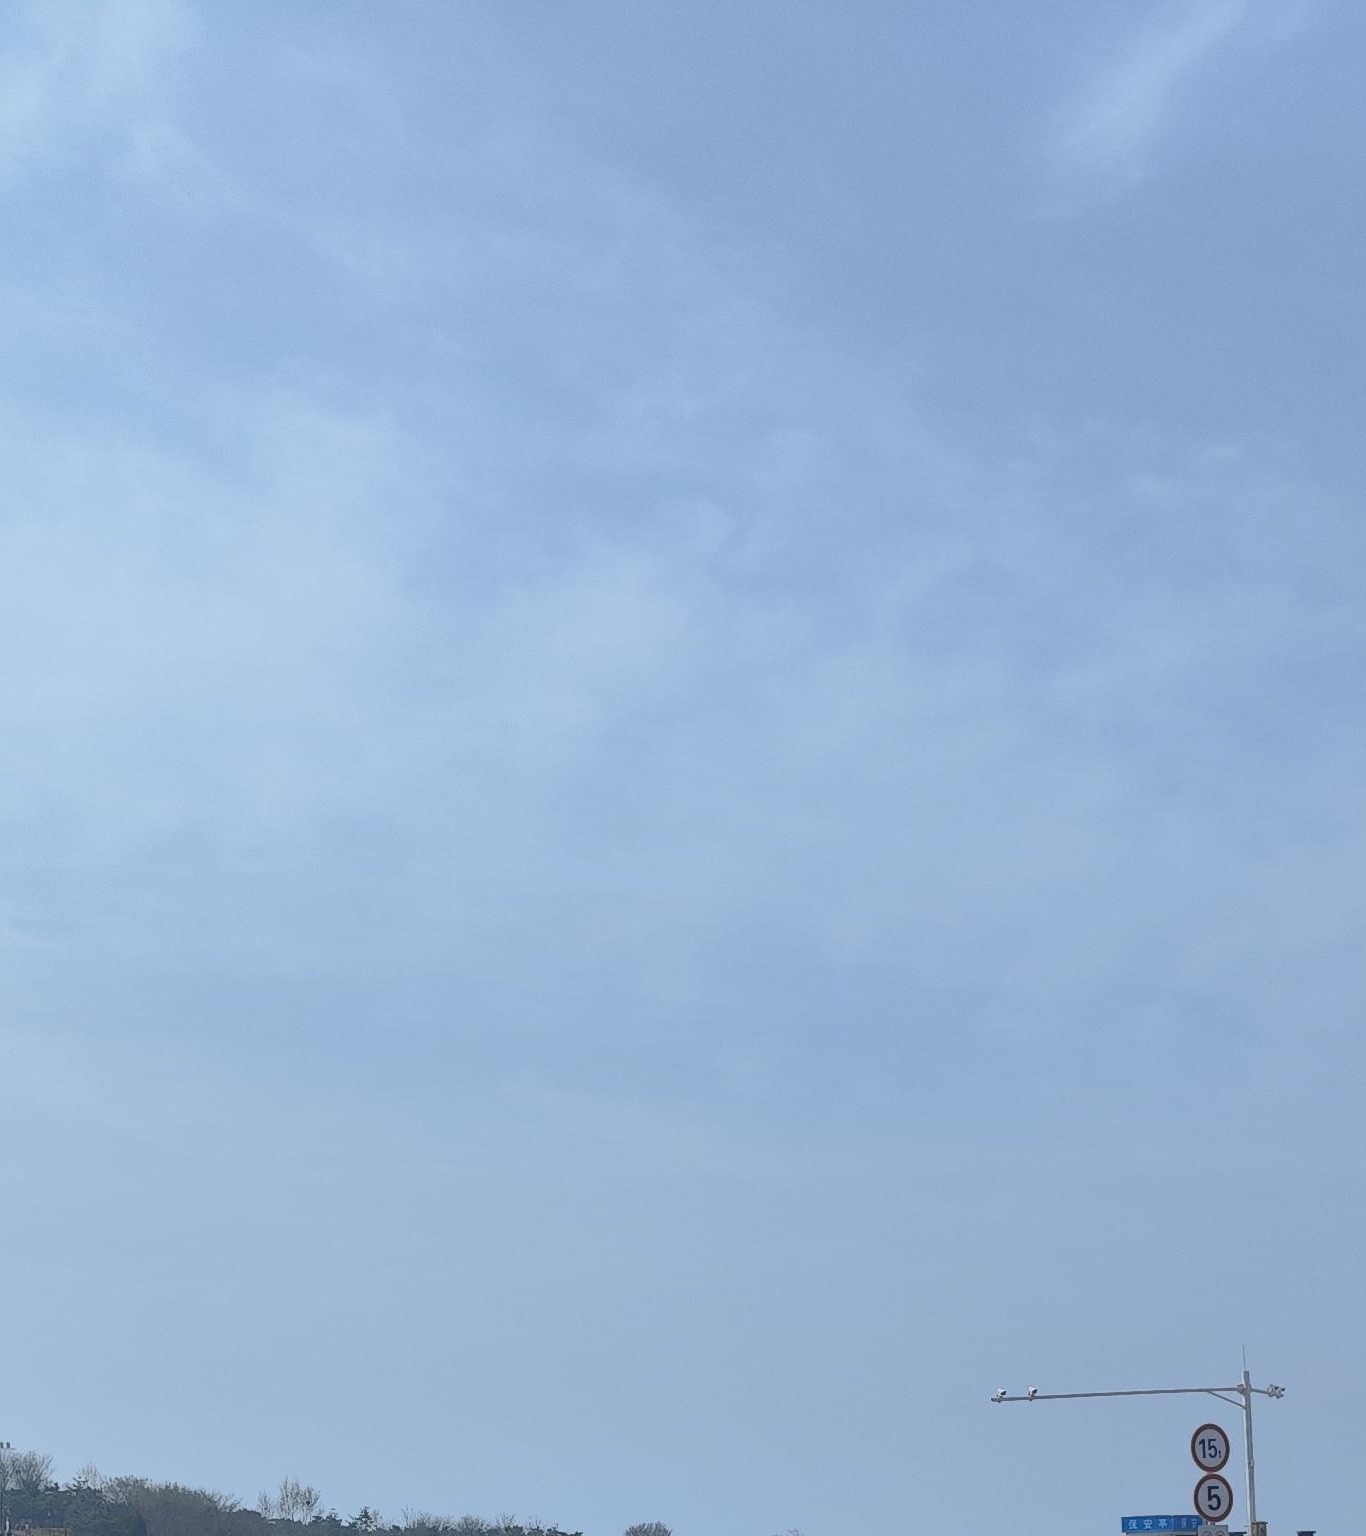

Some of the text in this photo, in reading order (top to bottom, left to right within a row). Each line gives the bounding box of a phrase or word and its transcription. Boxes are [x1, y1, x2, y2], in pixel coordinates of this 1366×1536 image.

[1207, 1485, 1222, 1511] 5
[1128, 1518, 1168, 1530] 保安亭
